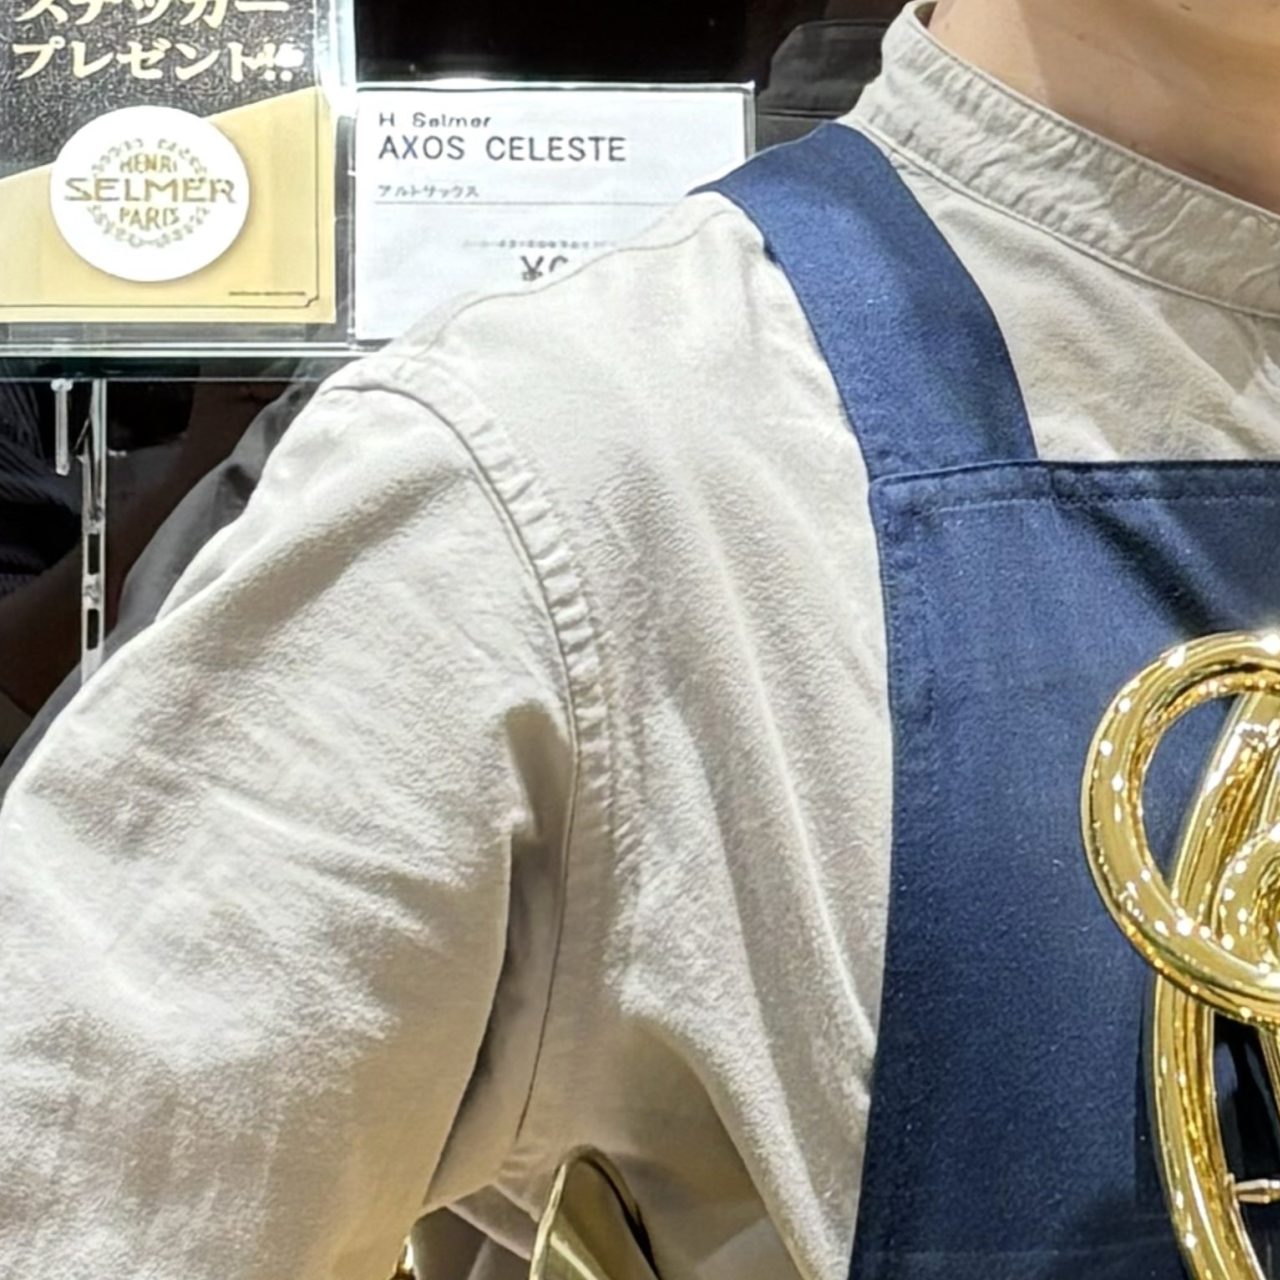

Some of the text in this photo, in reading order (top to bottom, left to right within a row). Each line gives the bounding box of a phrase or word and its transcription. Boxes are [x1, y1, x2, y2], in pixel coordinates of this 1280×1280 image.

[378, 135, 627, 162] AXOS CELESTE
[119, 153, 179, 174] HENRI
[64, 177, 237, 203] SELMER
